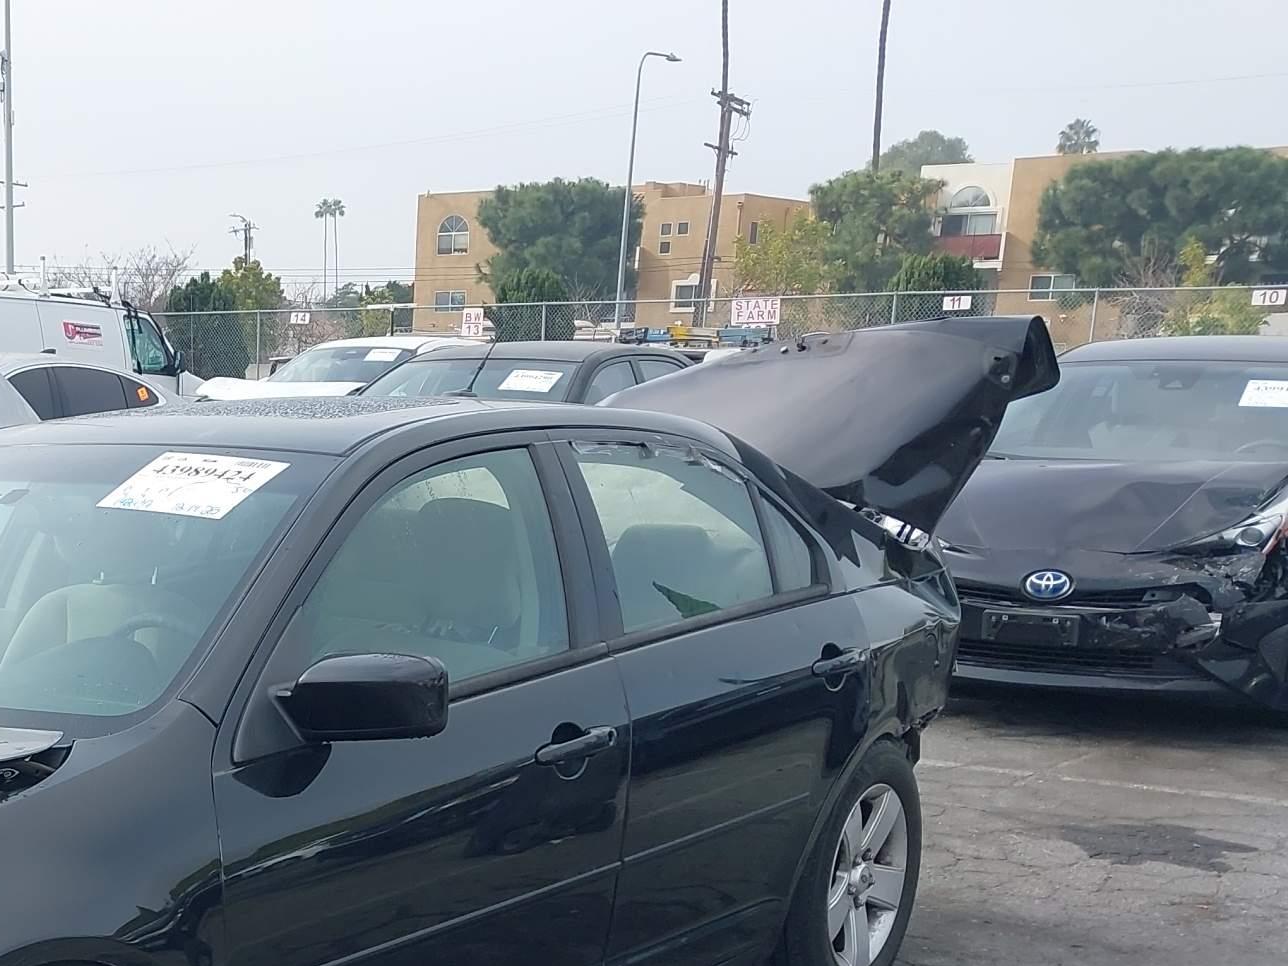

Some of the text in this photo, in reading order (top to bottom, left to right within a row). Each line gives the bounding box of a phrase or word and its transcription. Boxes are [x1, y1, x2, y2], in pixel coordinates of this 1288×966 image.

[950, 296, 962, 309] 11
[1260, 291, 1280, 304] 10
[735, 300, 779, 310] STATE
[294, 313, 306, 323] 14
[736, 310, 777, 320] FARM
[466, 325, 480, 335] 13
[153, 463, 257, 482] 43989424
